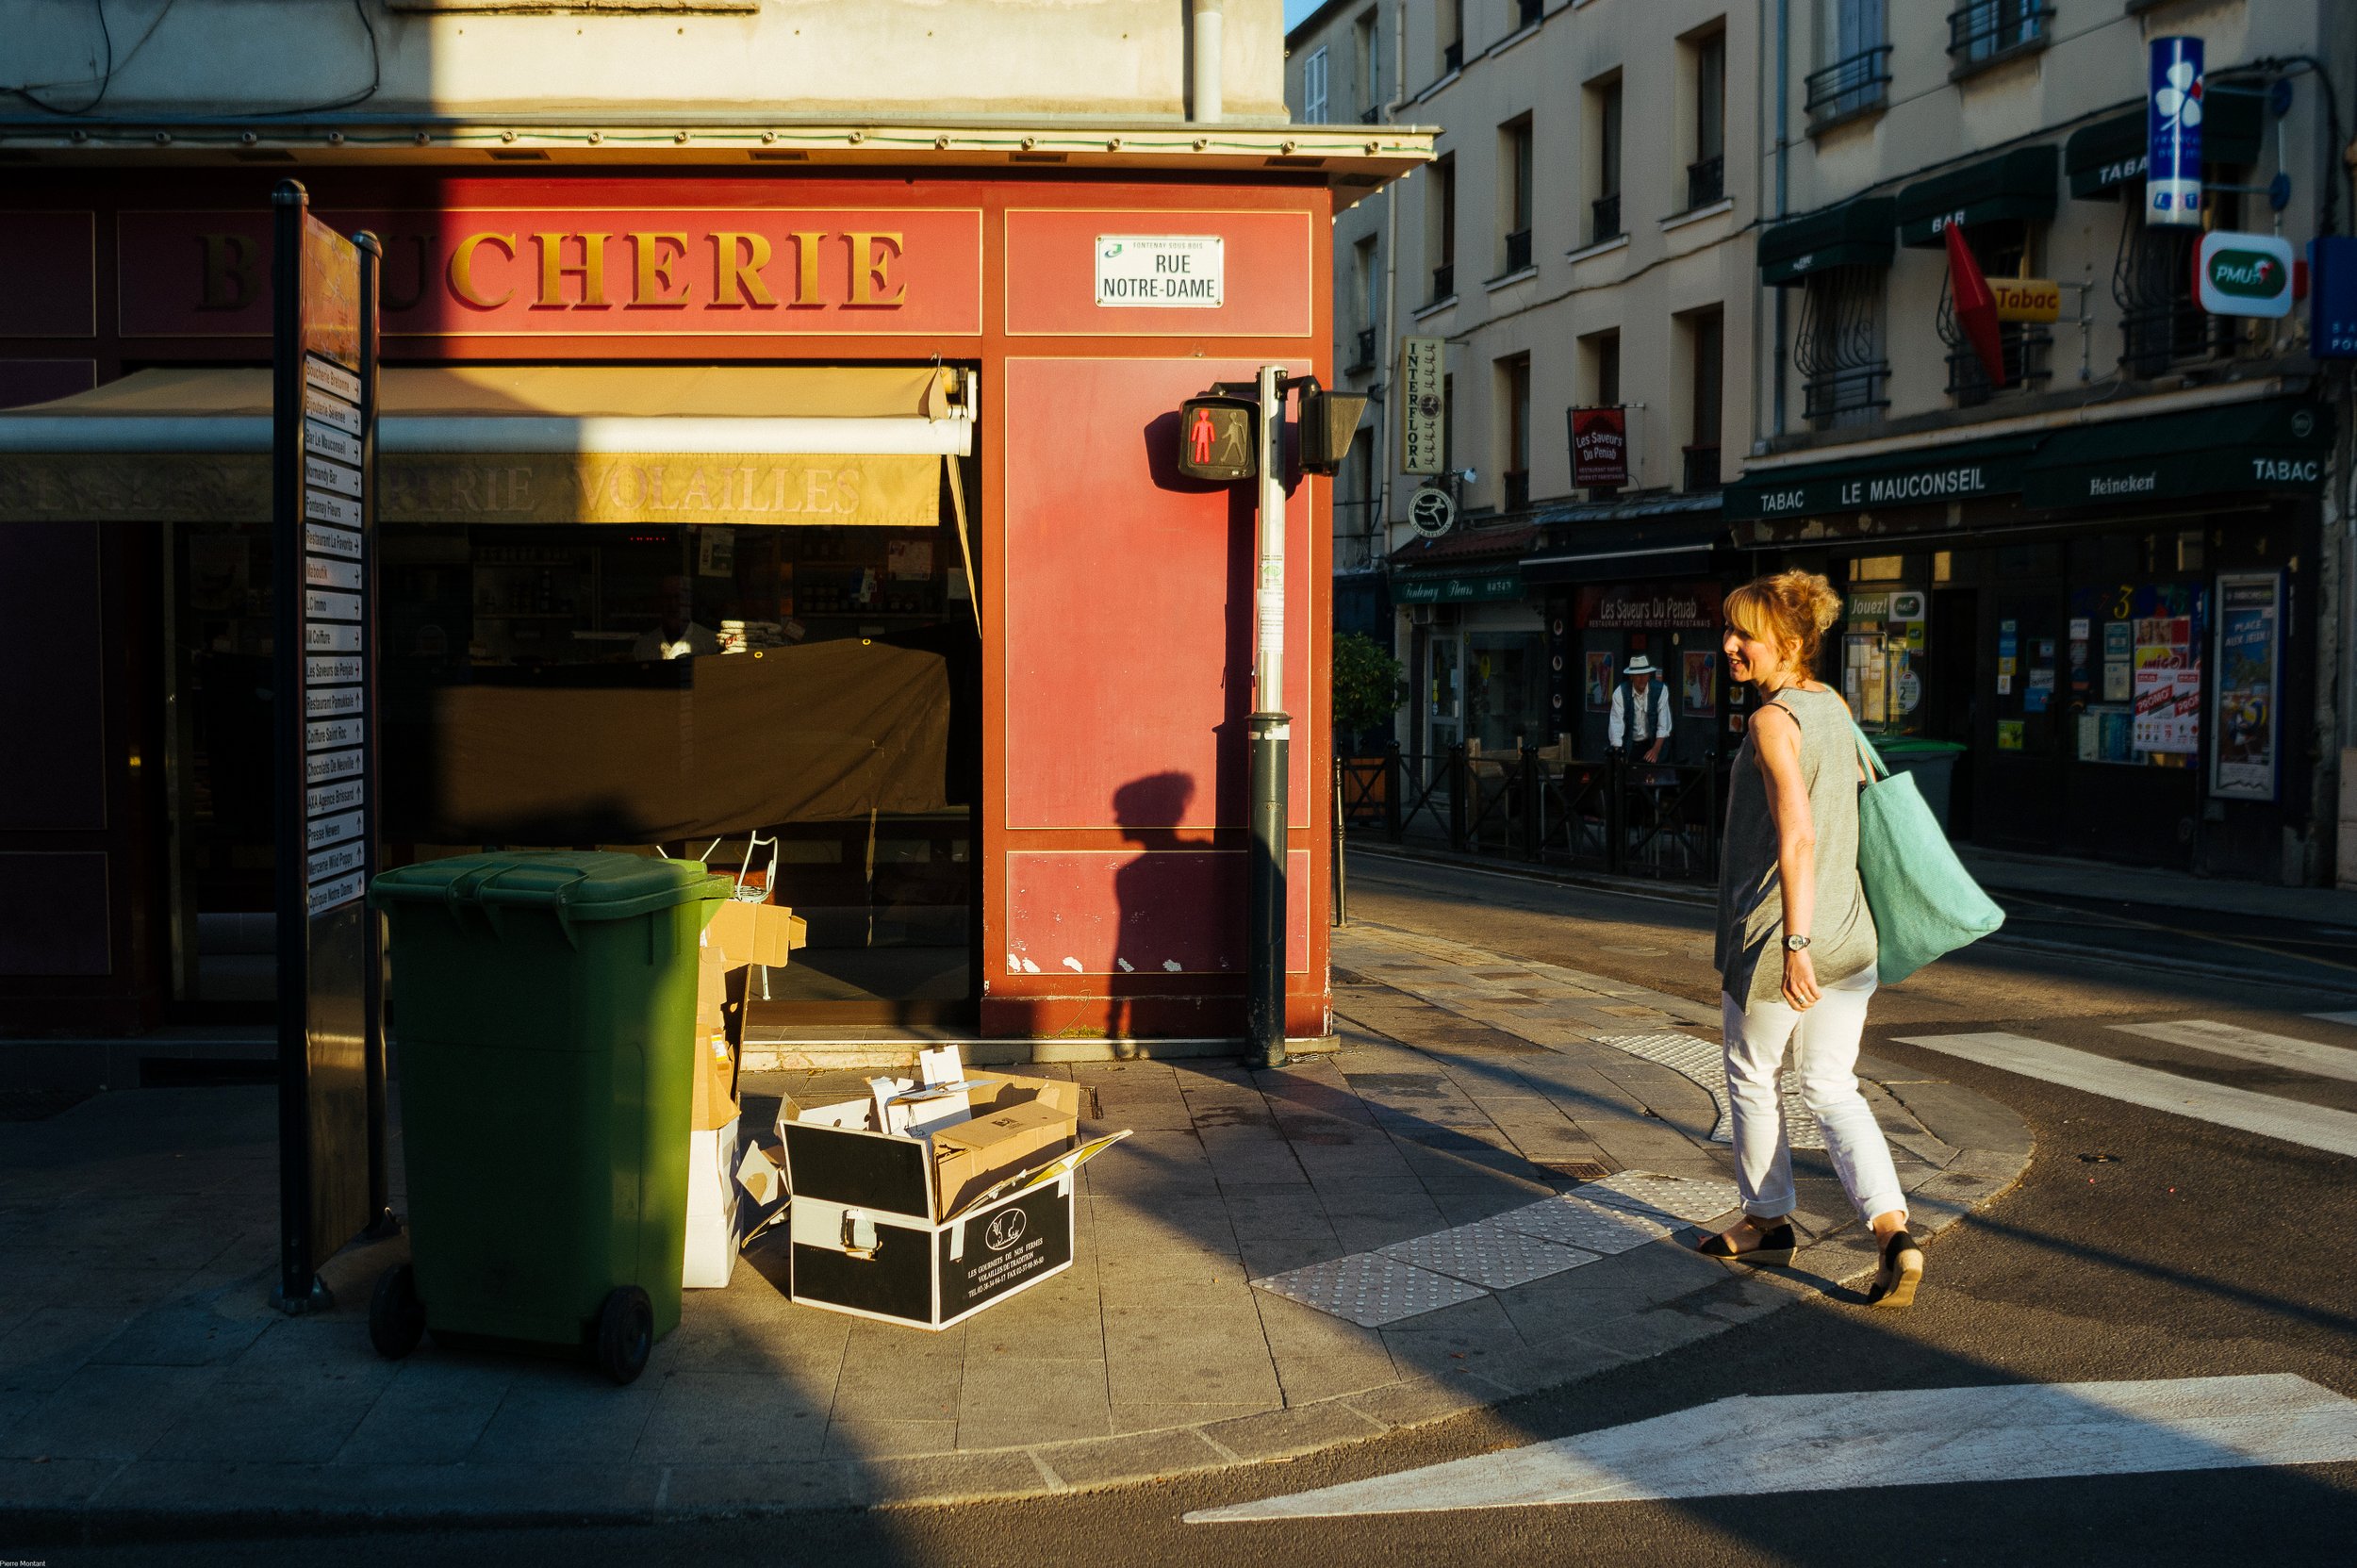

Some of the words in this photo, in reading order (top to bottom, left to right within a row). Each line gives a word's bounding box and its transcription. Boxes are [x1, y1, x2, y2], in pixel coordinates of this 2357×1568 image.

[2099, 156, 2148, 186] TABA
[1931, 208, 1967, 234] BAR
[1133, 241, 1167, 250] FONTENAY
[1188, 242, 1204, 251] BOIS
[194, 231, 907, 311] BUCHERIE
[1156, 255, 1191, 273] RUE
[2214, 264, 2254, 285] PMU
[1103, 278, 1215, 298] NOTRE-DAME
[1995, 286, 2059, 310] Tabac
[1407, 343, 1418, 469] INTERFLORA
[315, 432, 321, 447] Le
[1575, 435, 1591, 449] Les
[1591, 431, 1623, 447] Saveurs
[1583, 449, 1593, 461] Du
[329, 469, 338, 485] Bar
[2251, 458, 2319, 482] TABAC
[572, 466, 861, 515] VOLAILLES
[1759, 490, 1805, 512] TABAC
[1841, 482, 1862, 505] LE
[1870, 468, 1986, 503] MAUCONSEIL
[2089, 471, 2157, 496] Heineken
[327, 501, 341, 519] Fleurs
[1601, 600, 1614, 619] Les
[1616, 599, 1650, 619] Saveurs
[1653, 597, 1664, 619] Du
[1851, 597, 1888, 616] Jouez!
[1589, 619, 1623, 628] RESTAURANT
[2137, 688, 2170, 712] PROMO
[307, 794, 318, 809] AXA
[967, 1268, 978, 1279] LES
[1004, 1251, 1013, 1261] DE
[978, 1264, 1003, 1283] VOLAILLES
